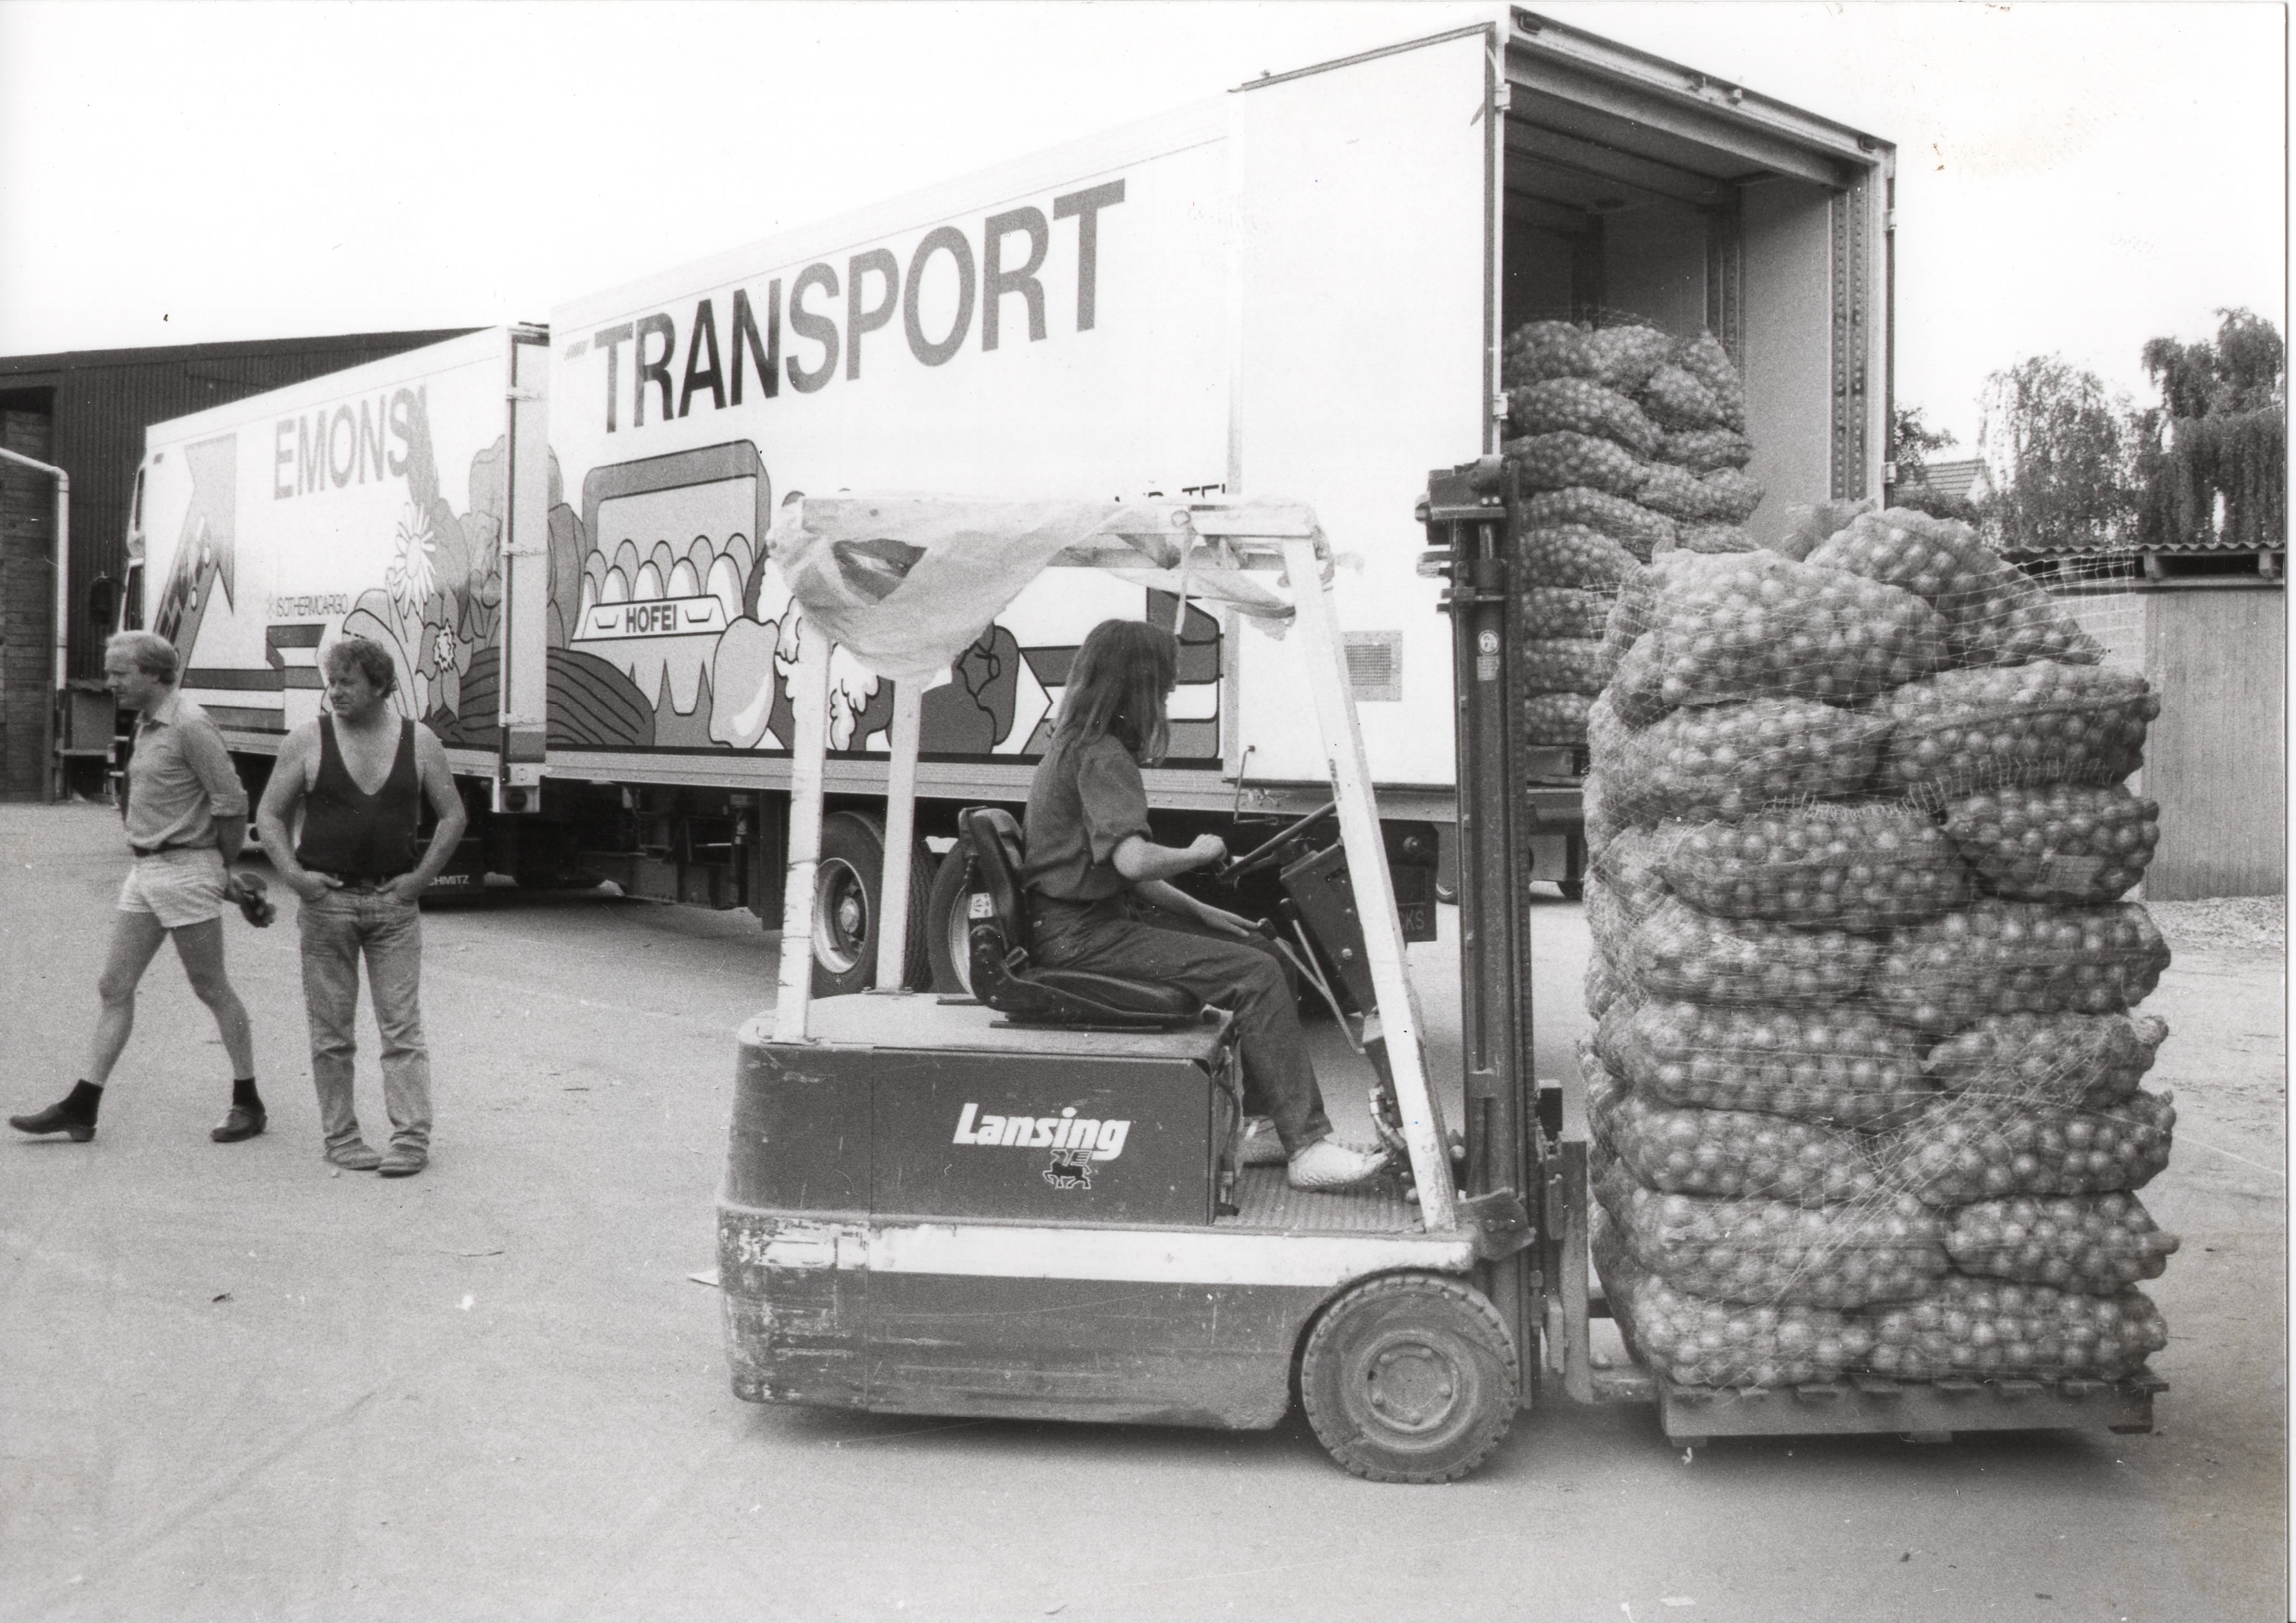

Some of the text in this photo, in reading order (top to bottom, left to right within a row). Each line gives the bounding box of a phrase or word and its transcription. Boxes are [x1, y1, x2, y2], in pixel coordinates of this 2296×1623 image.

[594, 178, 1125, 433] TRANSPORT
[274, 387, 416, 500] EMONS
[428, 875, 470, 885] HMITZ
[953, 1103, 1131, 1160] Lansing
